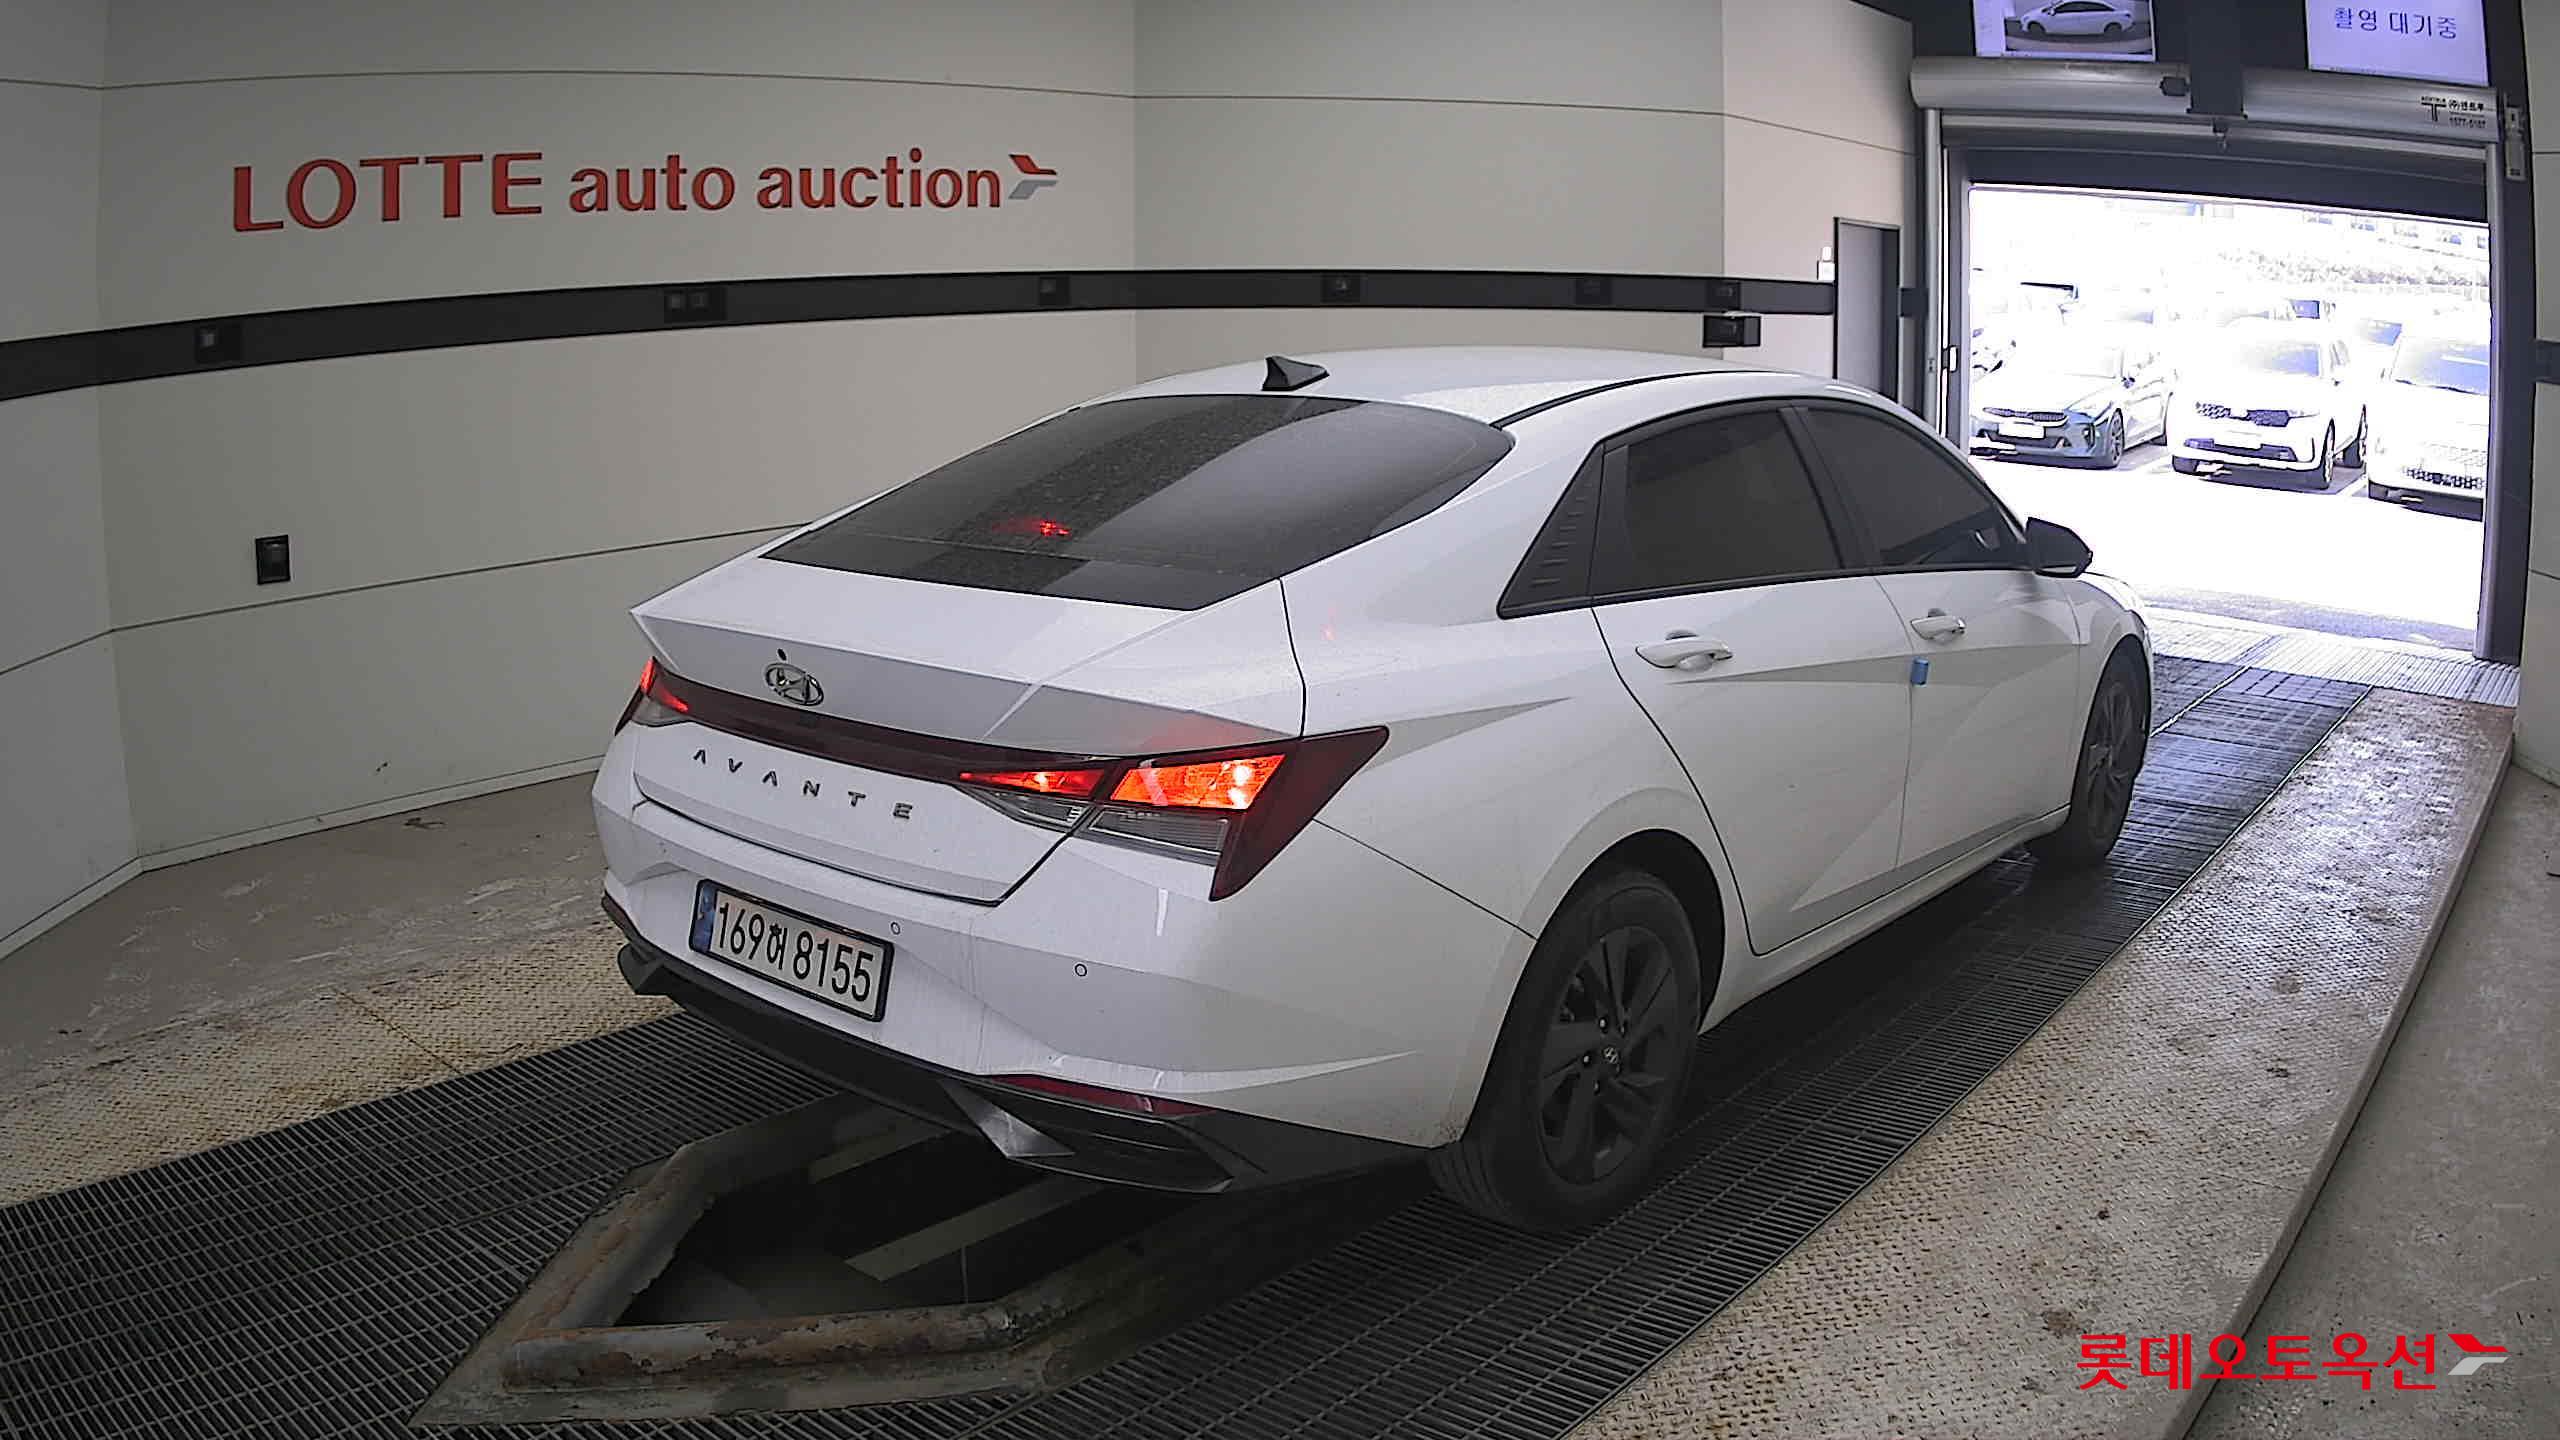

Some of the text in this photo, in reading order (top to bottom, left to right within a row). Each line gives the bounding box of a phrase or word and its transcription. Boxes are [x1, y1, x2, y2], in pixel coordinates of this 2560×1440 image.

[2335, 7, 2457, 40] 촬영 대기중
[235, 149, 1001, 231] LOTTE auto auction
[693, 748, 912, 820] AVANTE
[717, 902, 874, 1002] 169허 8155
